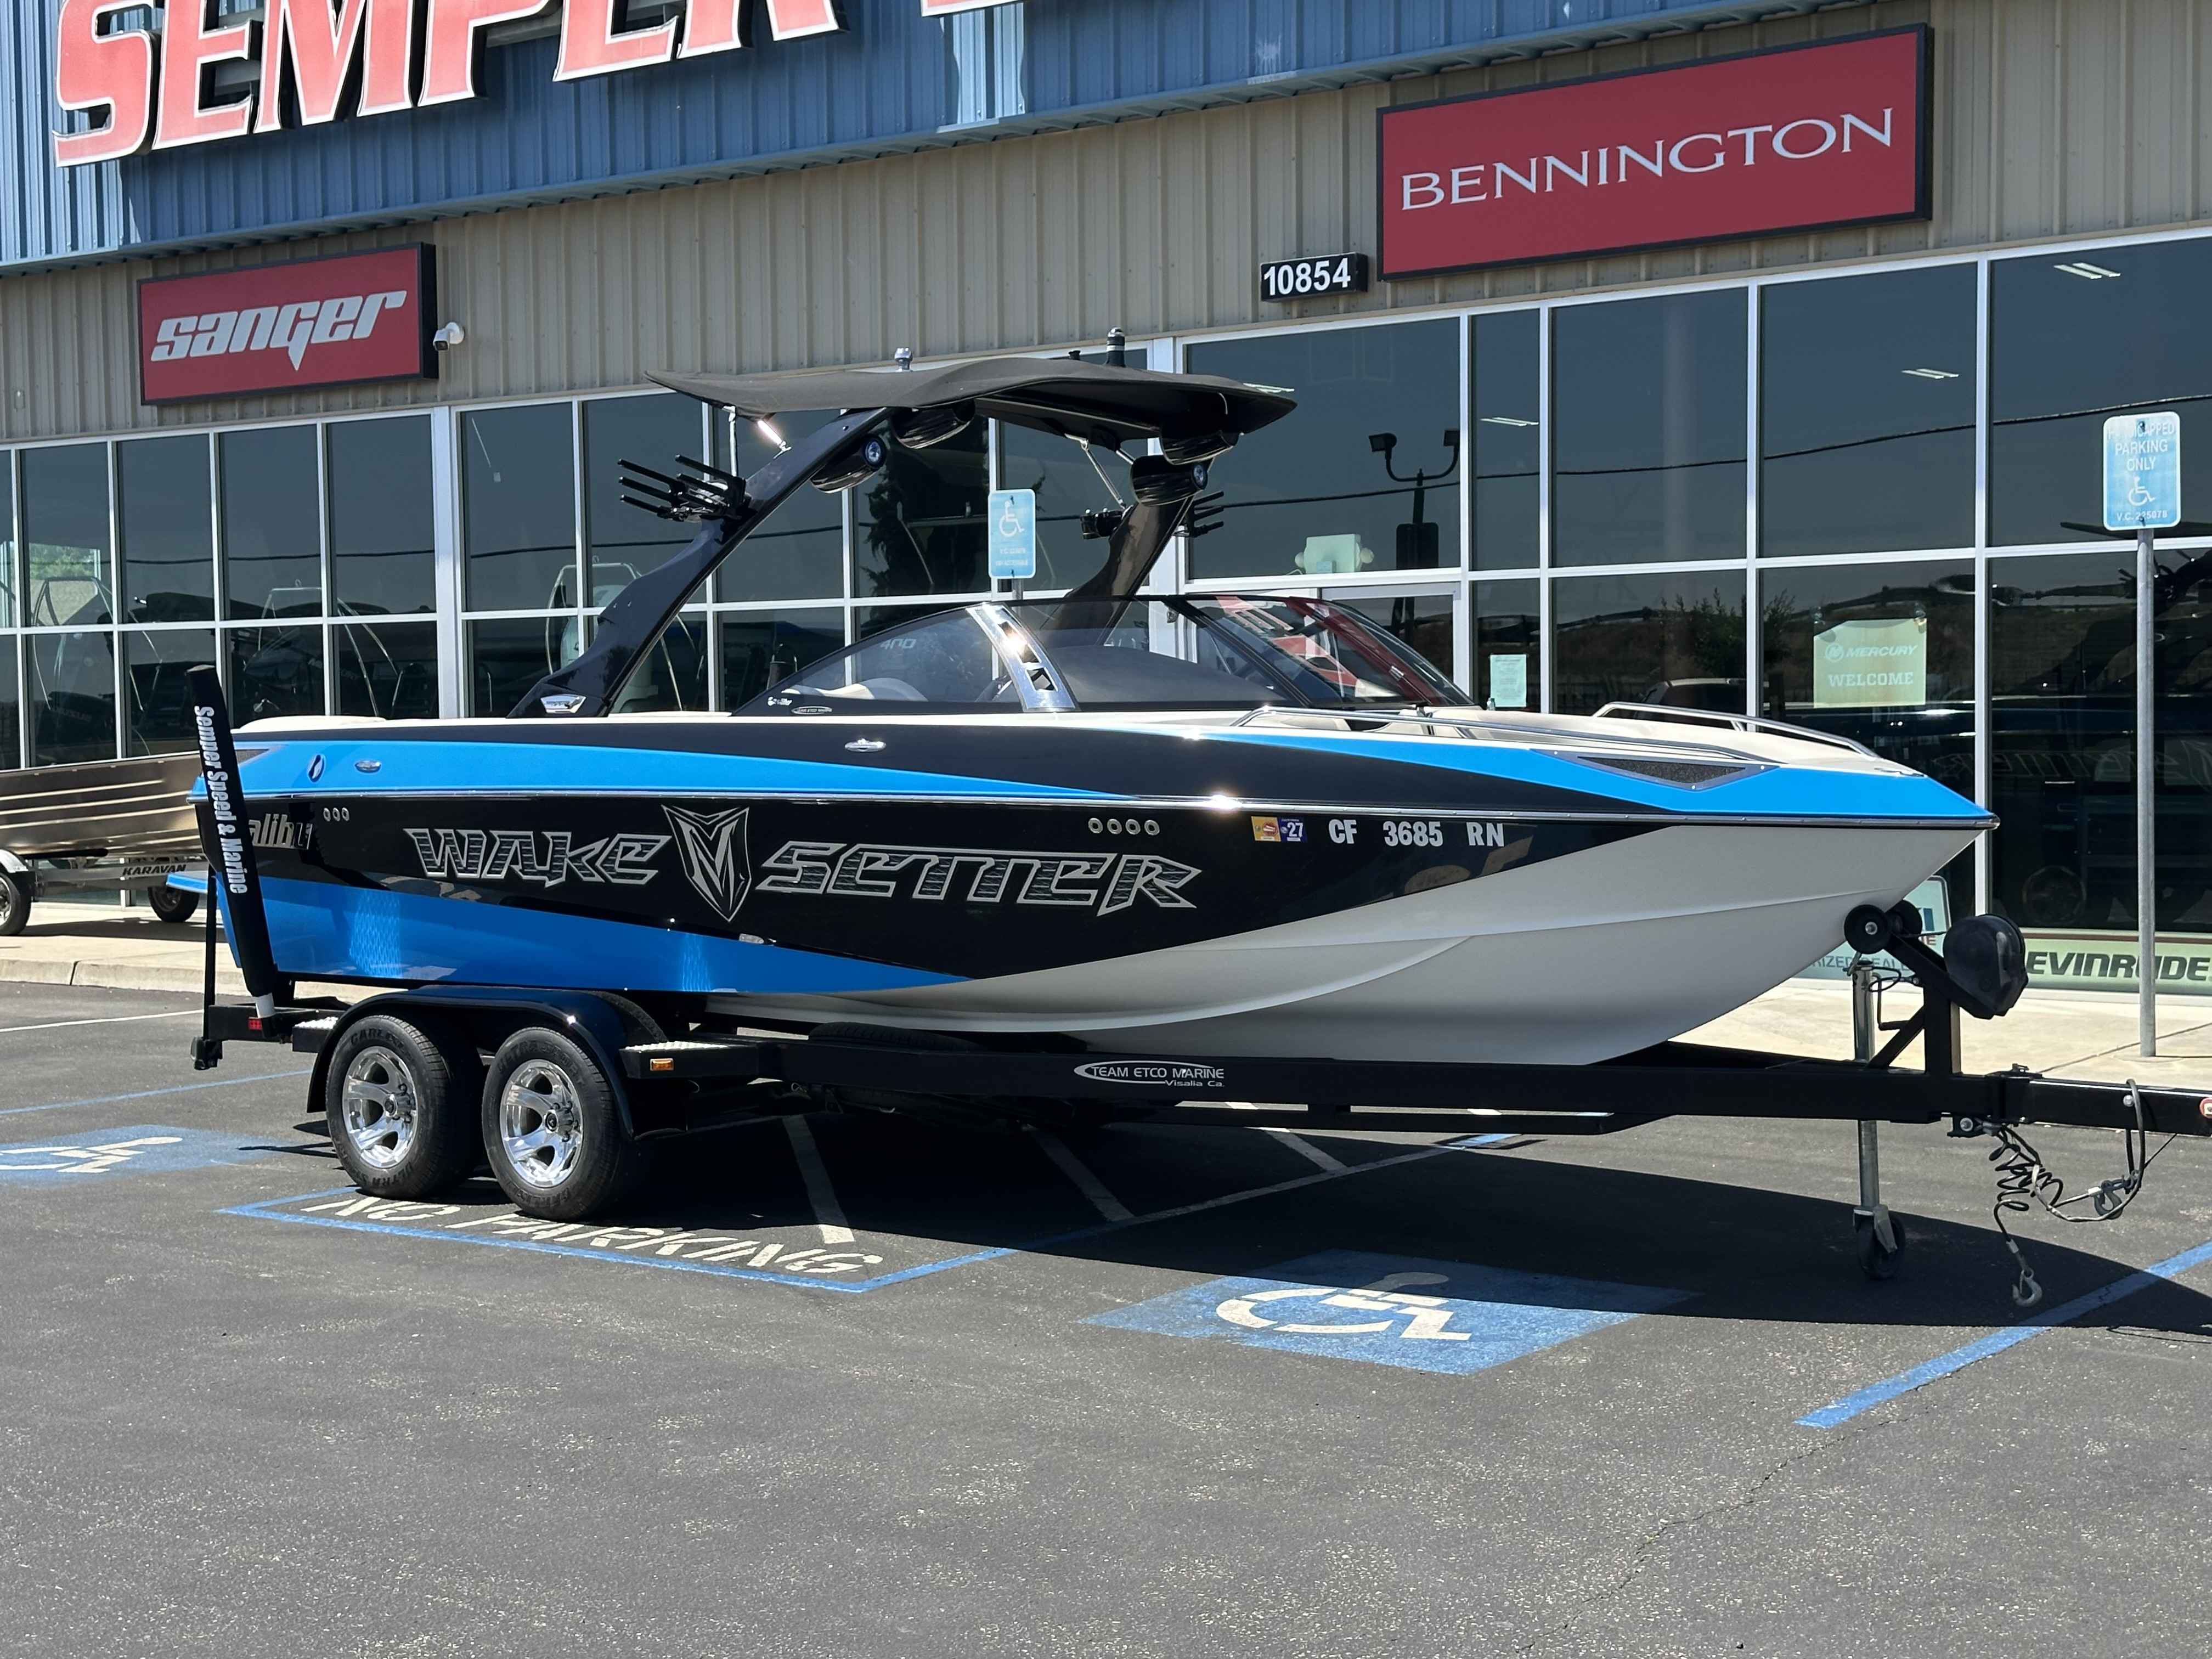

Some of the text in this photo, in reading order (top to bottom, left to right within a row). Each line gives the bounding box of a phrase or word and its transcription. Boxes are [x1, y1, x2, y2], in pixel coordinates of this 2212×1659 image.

[1401, 108, 1893, 210] BENNINGTON
[1264, 258, 1351, 296] 10854
[2115, 439, 2168, 455] PARKING
[2126, 457, 2155, 471] ONLY
[1846, 645, 1918, 657] MERCURY
[1829, 672, 1914, 686] WELCOME
[194, 706, 247, 894] Semper Speed & Marine
[249, 813, 313, 850] alibu
[1287, 822, 1303, 837] 27
[1329, 819, 1504, 847] CF 3685 RN
[122, 864, 187, 876] KARAVAN
[2026, 951, 2211, 981] EVINRDE
[1091, 1066, 1224, 1079] TEAM ETCO MARINE
[301, 1196, 461, 1221] NO
